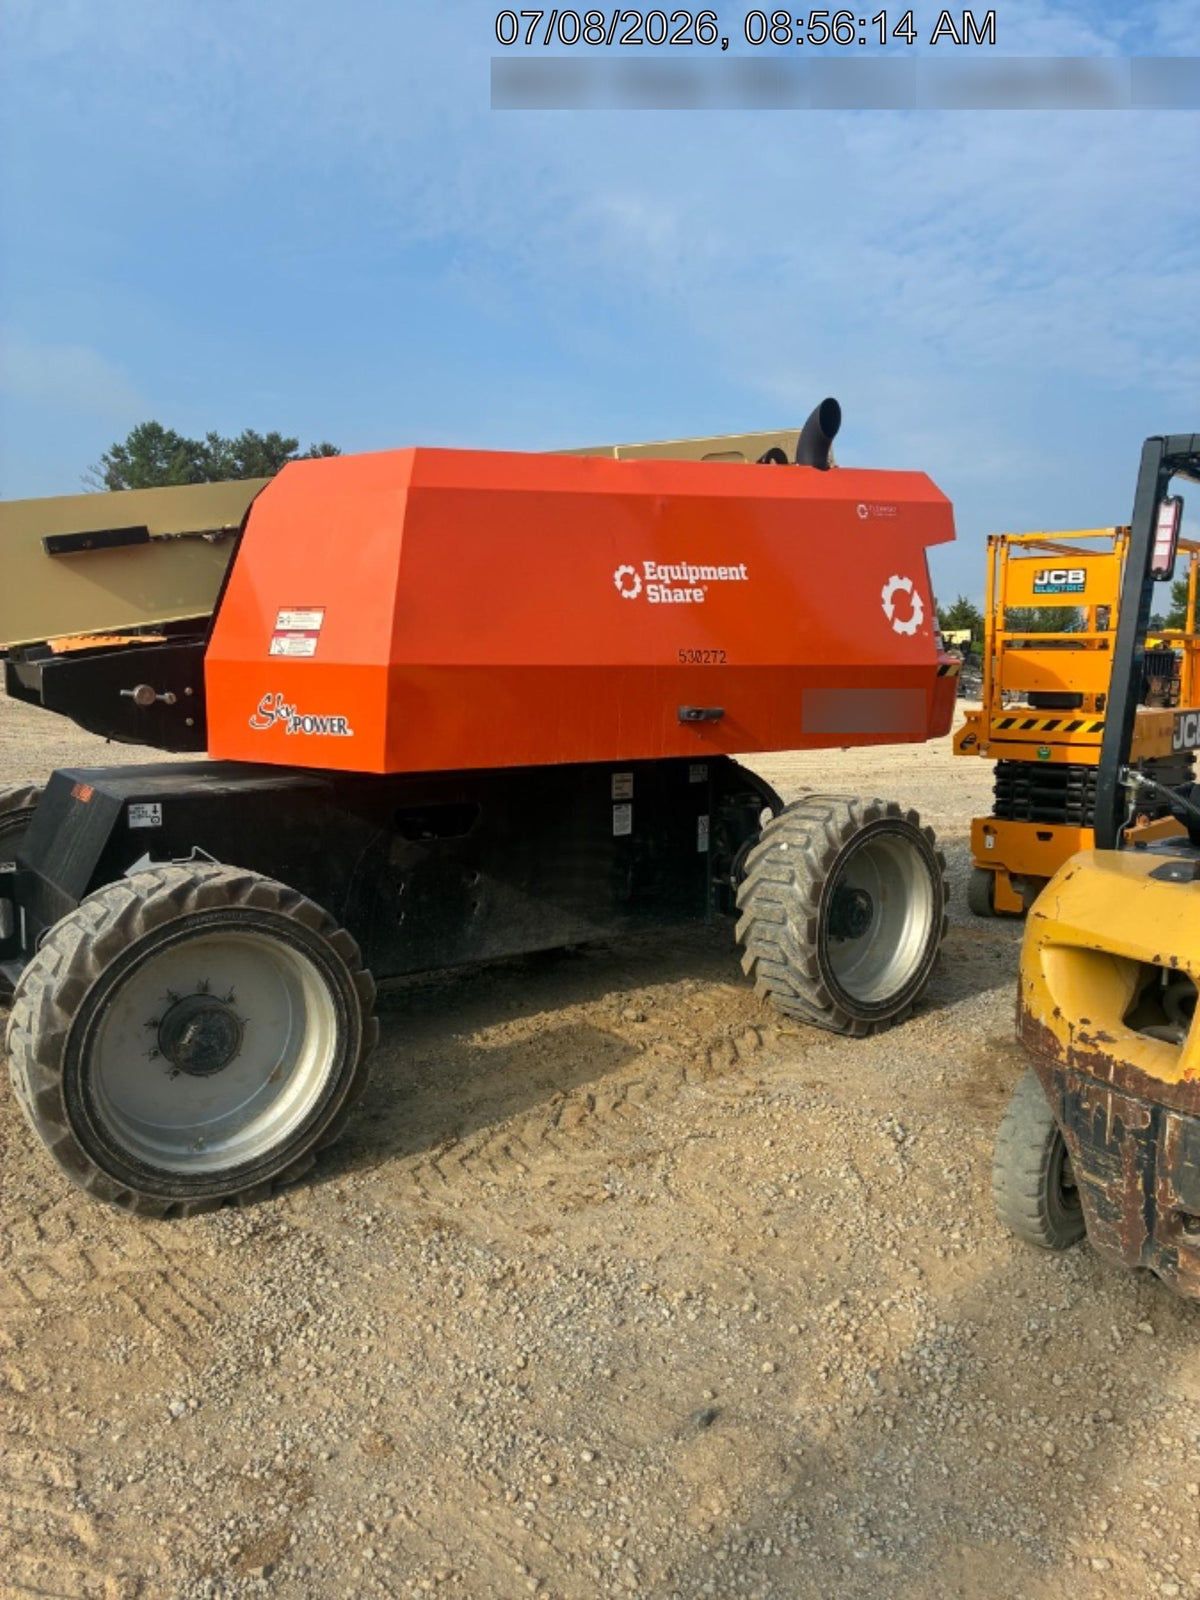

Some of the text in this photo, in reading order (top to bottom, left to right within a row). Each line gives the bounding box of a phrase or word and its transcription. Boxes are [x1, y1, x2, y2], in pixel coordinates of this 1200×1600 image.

[643, 561, 748, 583] Equipment
[1034, 570, 1085, 584] JCB
[249, 693, 297, 735] Sky
[290, 714, 354, 736] POWER
